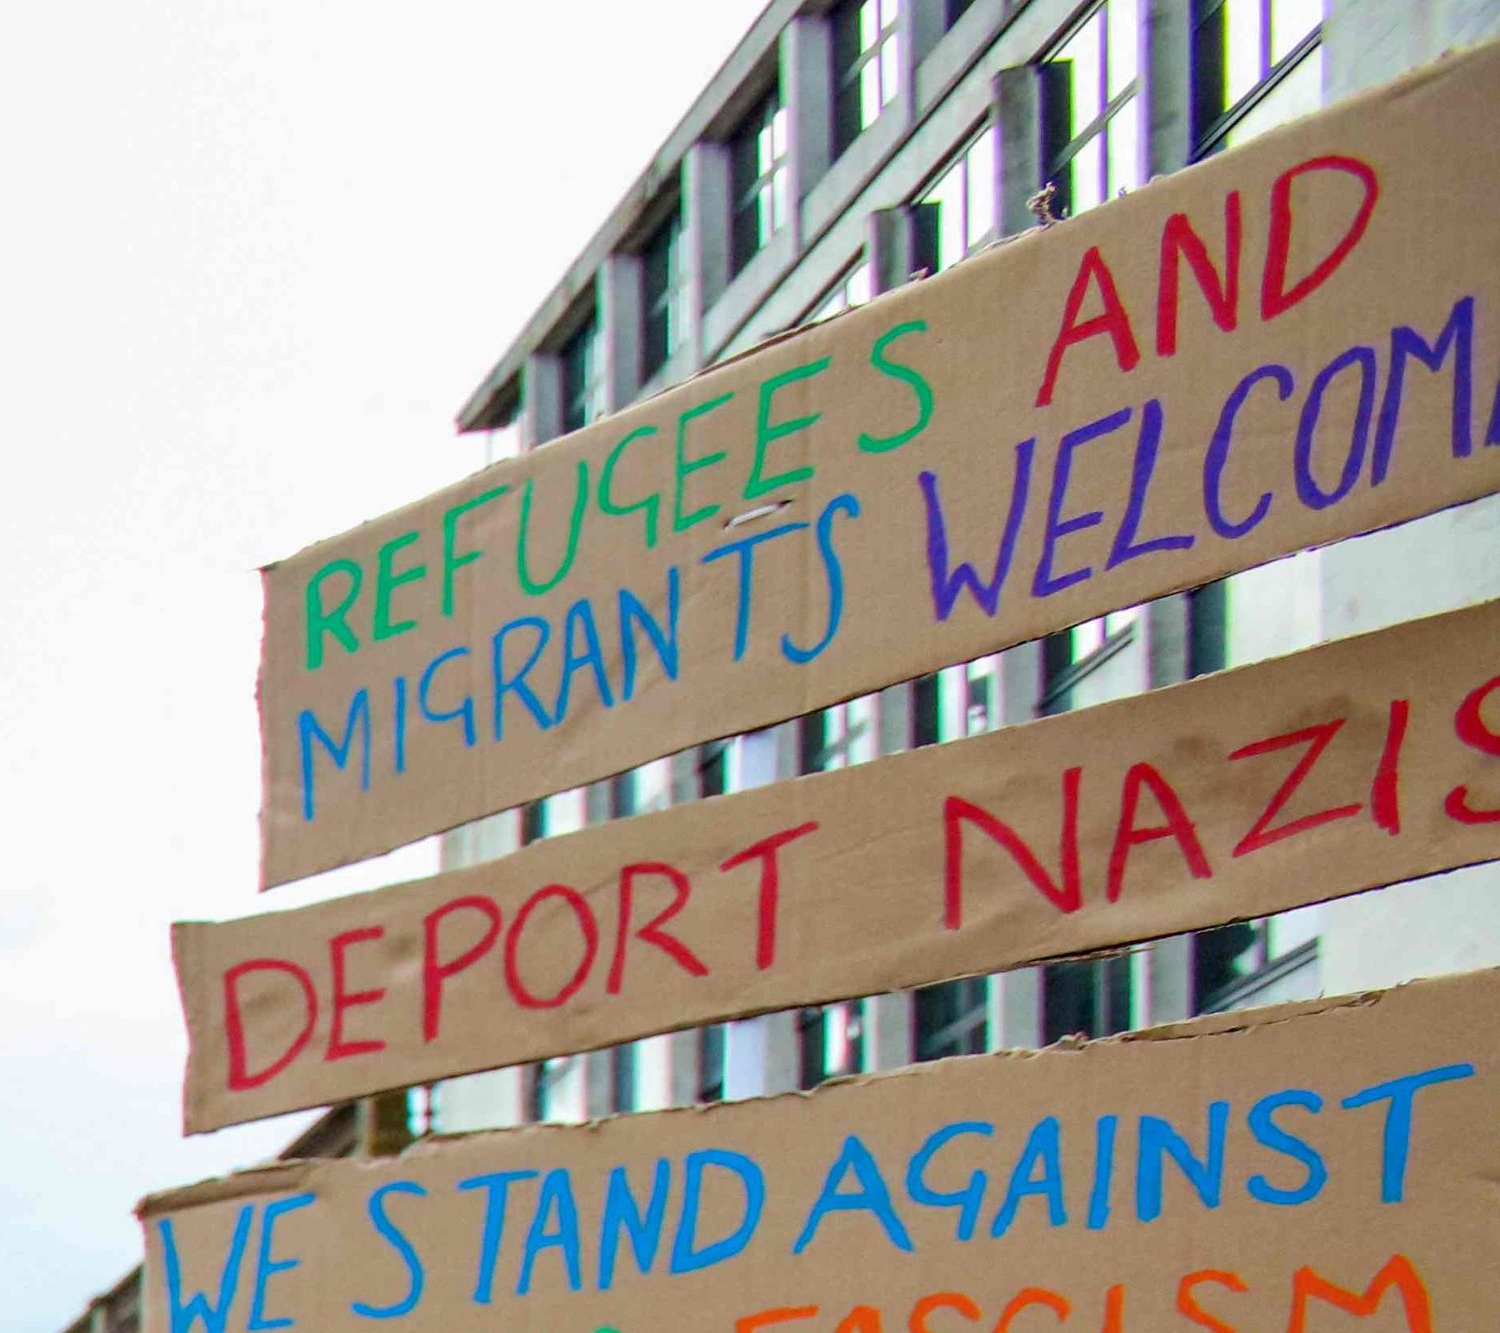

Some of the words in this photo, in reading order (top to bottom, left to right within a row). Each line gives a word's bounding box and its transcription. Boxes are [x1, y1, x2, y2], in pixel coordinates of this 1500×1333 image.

[297, 493, 860, 823] MIGRANTS
[918, 296, 1500, 626] WELCOM
[302, 318, 937, 673] REFUGEES
[1035, 154, 1380, 409] AND
[222, 819, 820, 1092] DEPORT
[940, 673, 1500, 930] NAZIS
[352, 1147, 765, 1322] STAND
[792, 1062, 1475, 1256] AGAINST
